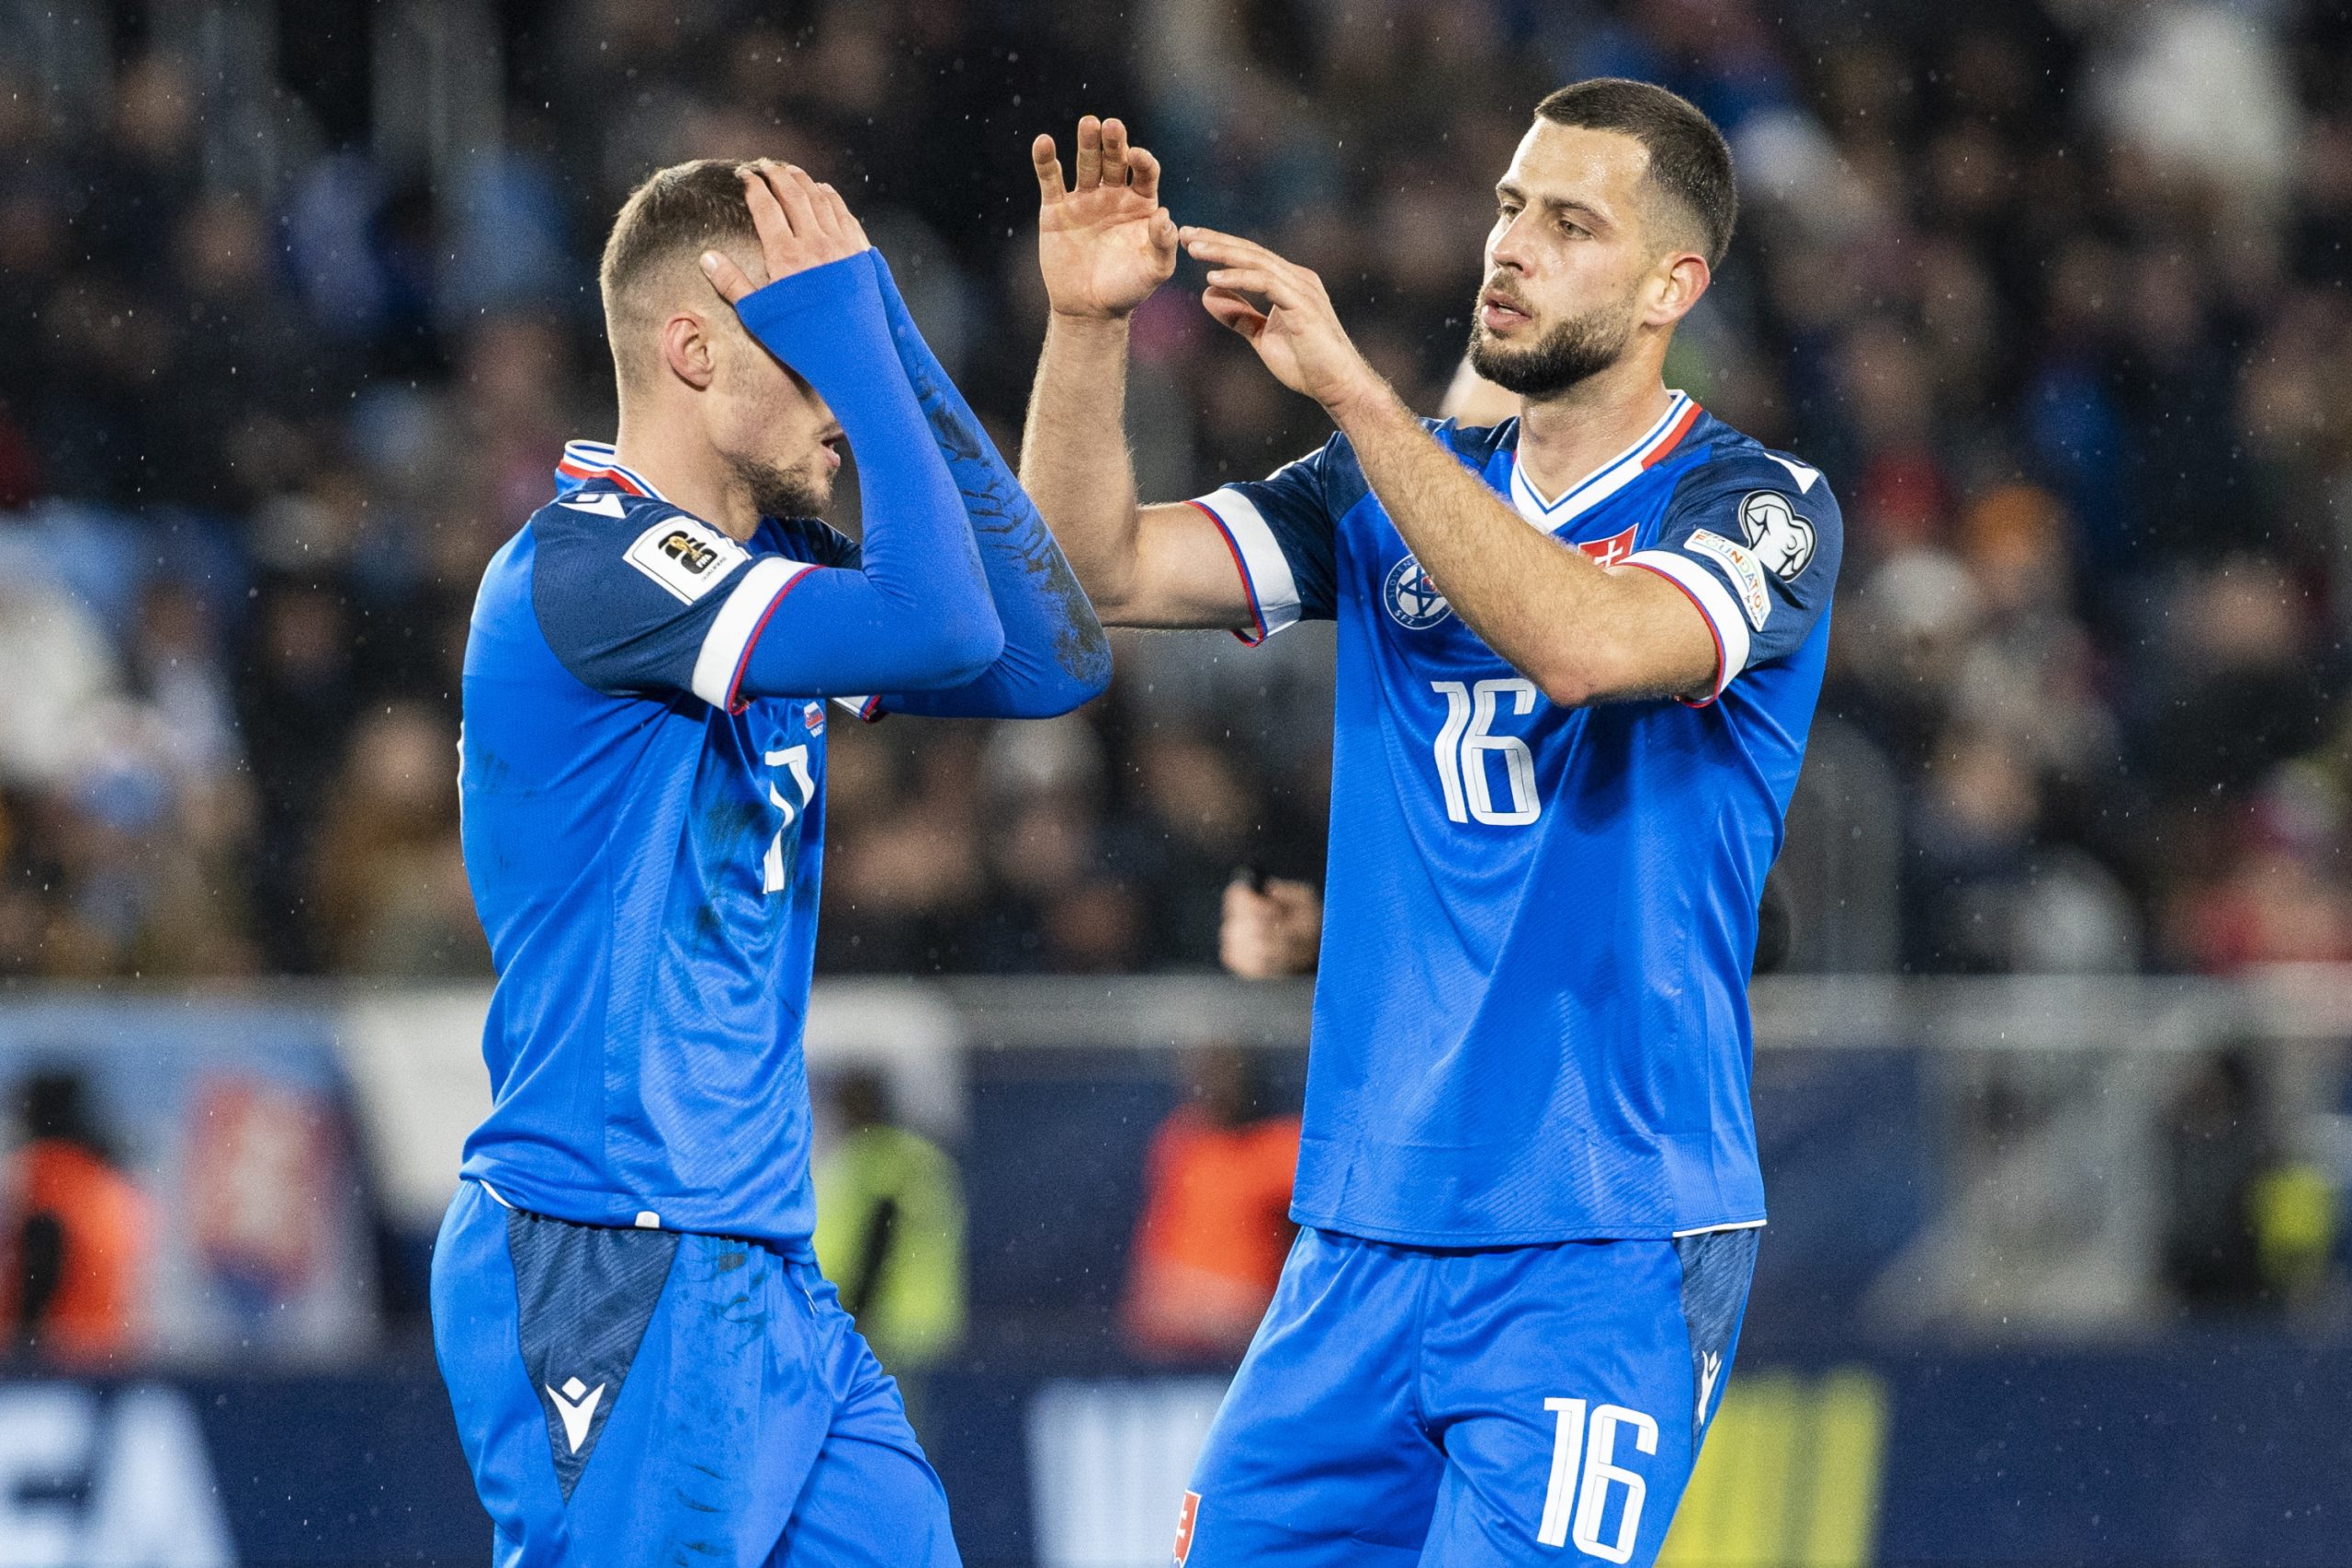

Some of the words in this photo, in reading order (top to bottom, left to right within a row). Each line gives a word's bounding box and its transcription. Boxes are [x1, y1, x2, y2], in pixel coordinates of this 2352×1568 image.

[1395, 609, 1416, 626] SFZ
[1694, 534, 1766, 619] FOUNDATION
[1430, 678, 1542, 825] 16
[1536, 1397, 1658, 1564] 16
